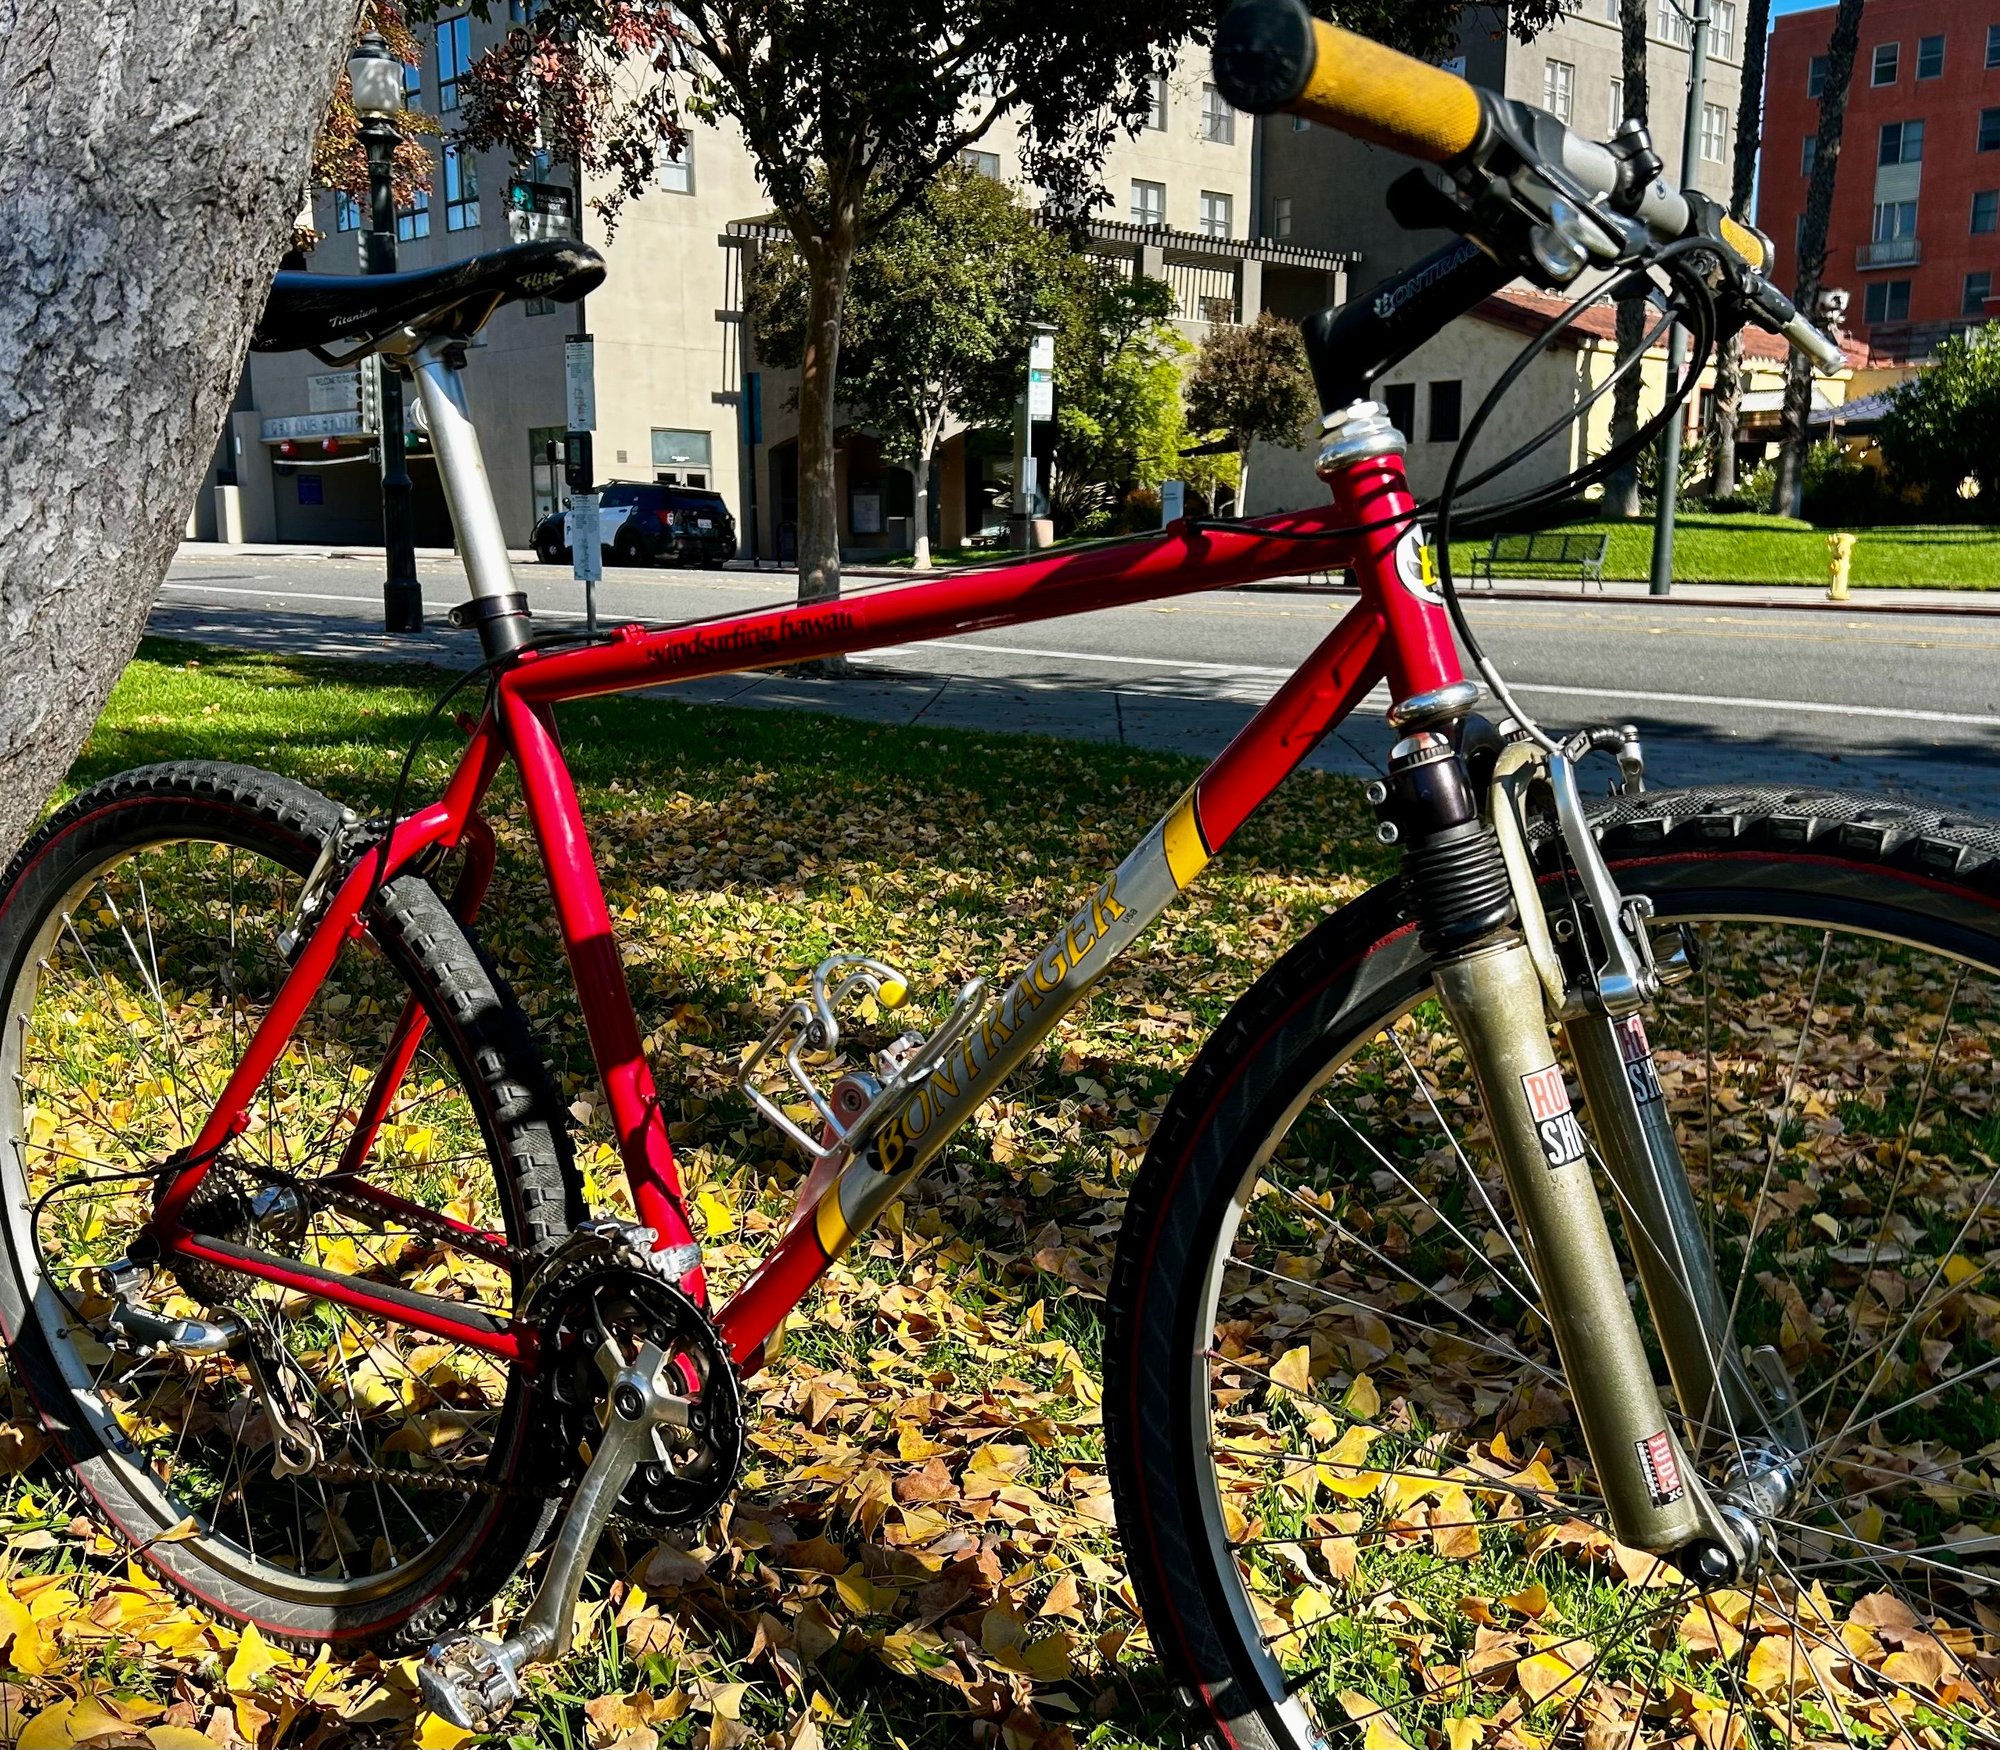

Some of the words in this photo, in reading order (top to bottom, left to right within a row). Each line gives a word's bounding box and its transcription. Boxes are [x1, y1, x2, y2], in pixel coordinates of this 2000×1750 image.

[516, 272, 564, 288] Flite
[1377, 241, 1480, 316] BONTRAG
[329, 306, 378, 328] Titanium
[877, 873, 1127, 1174] BONTRAGER
[1668, 1486, 1684, 1502] XC
